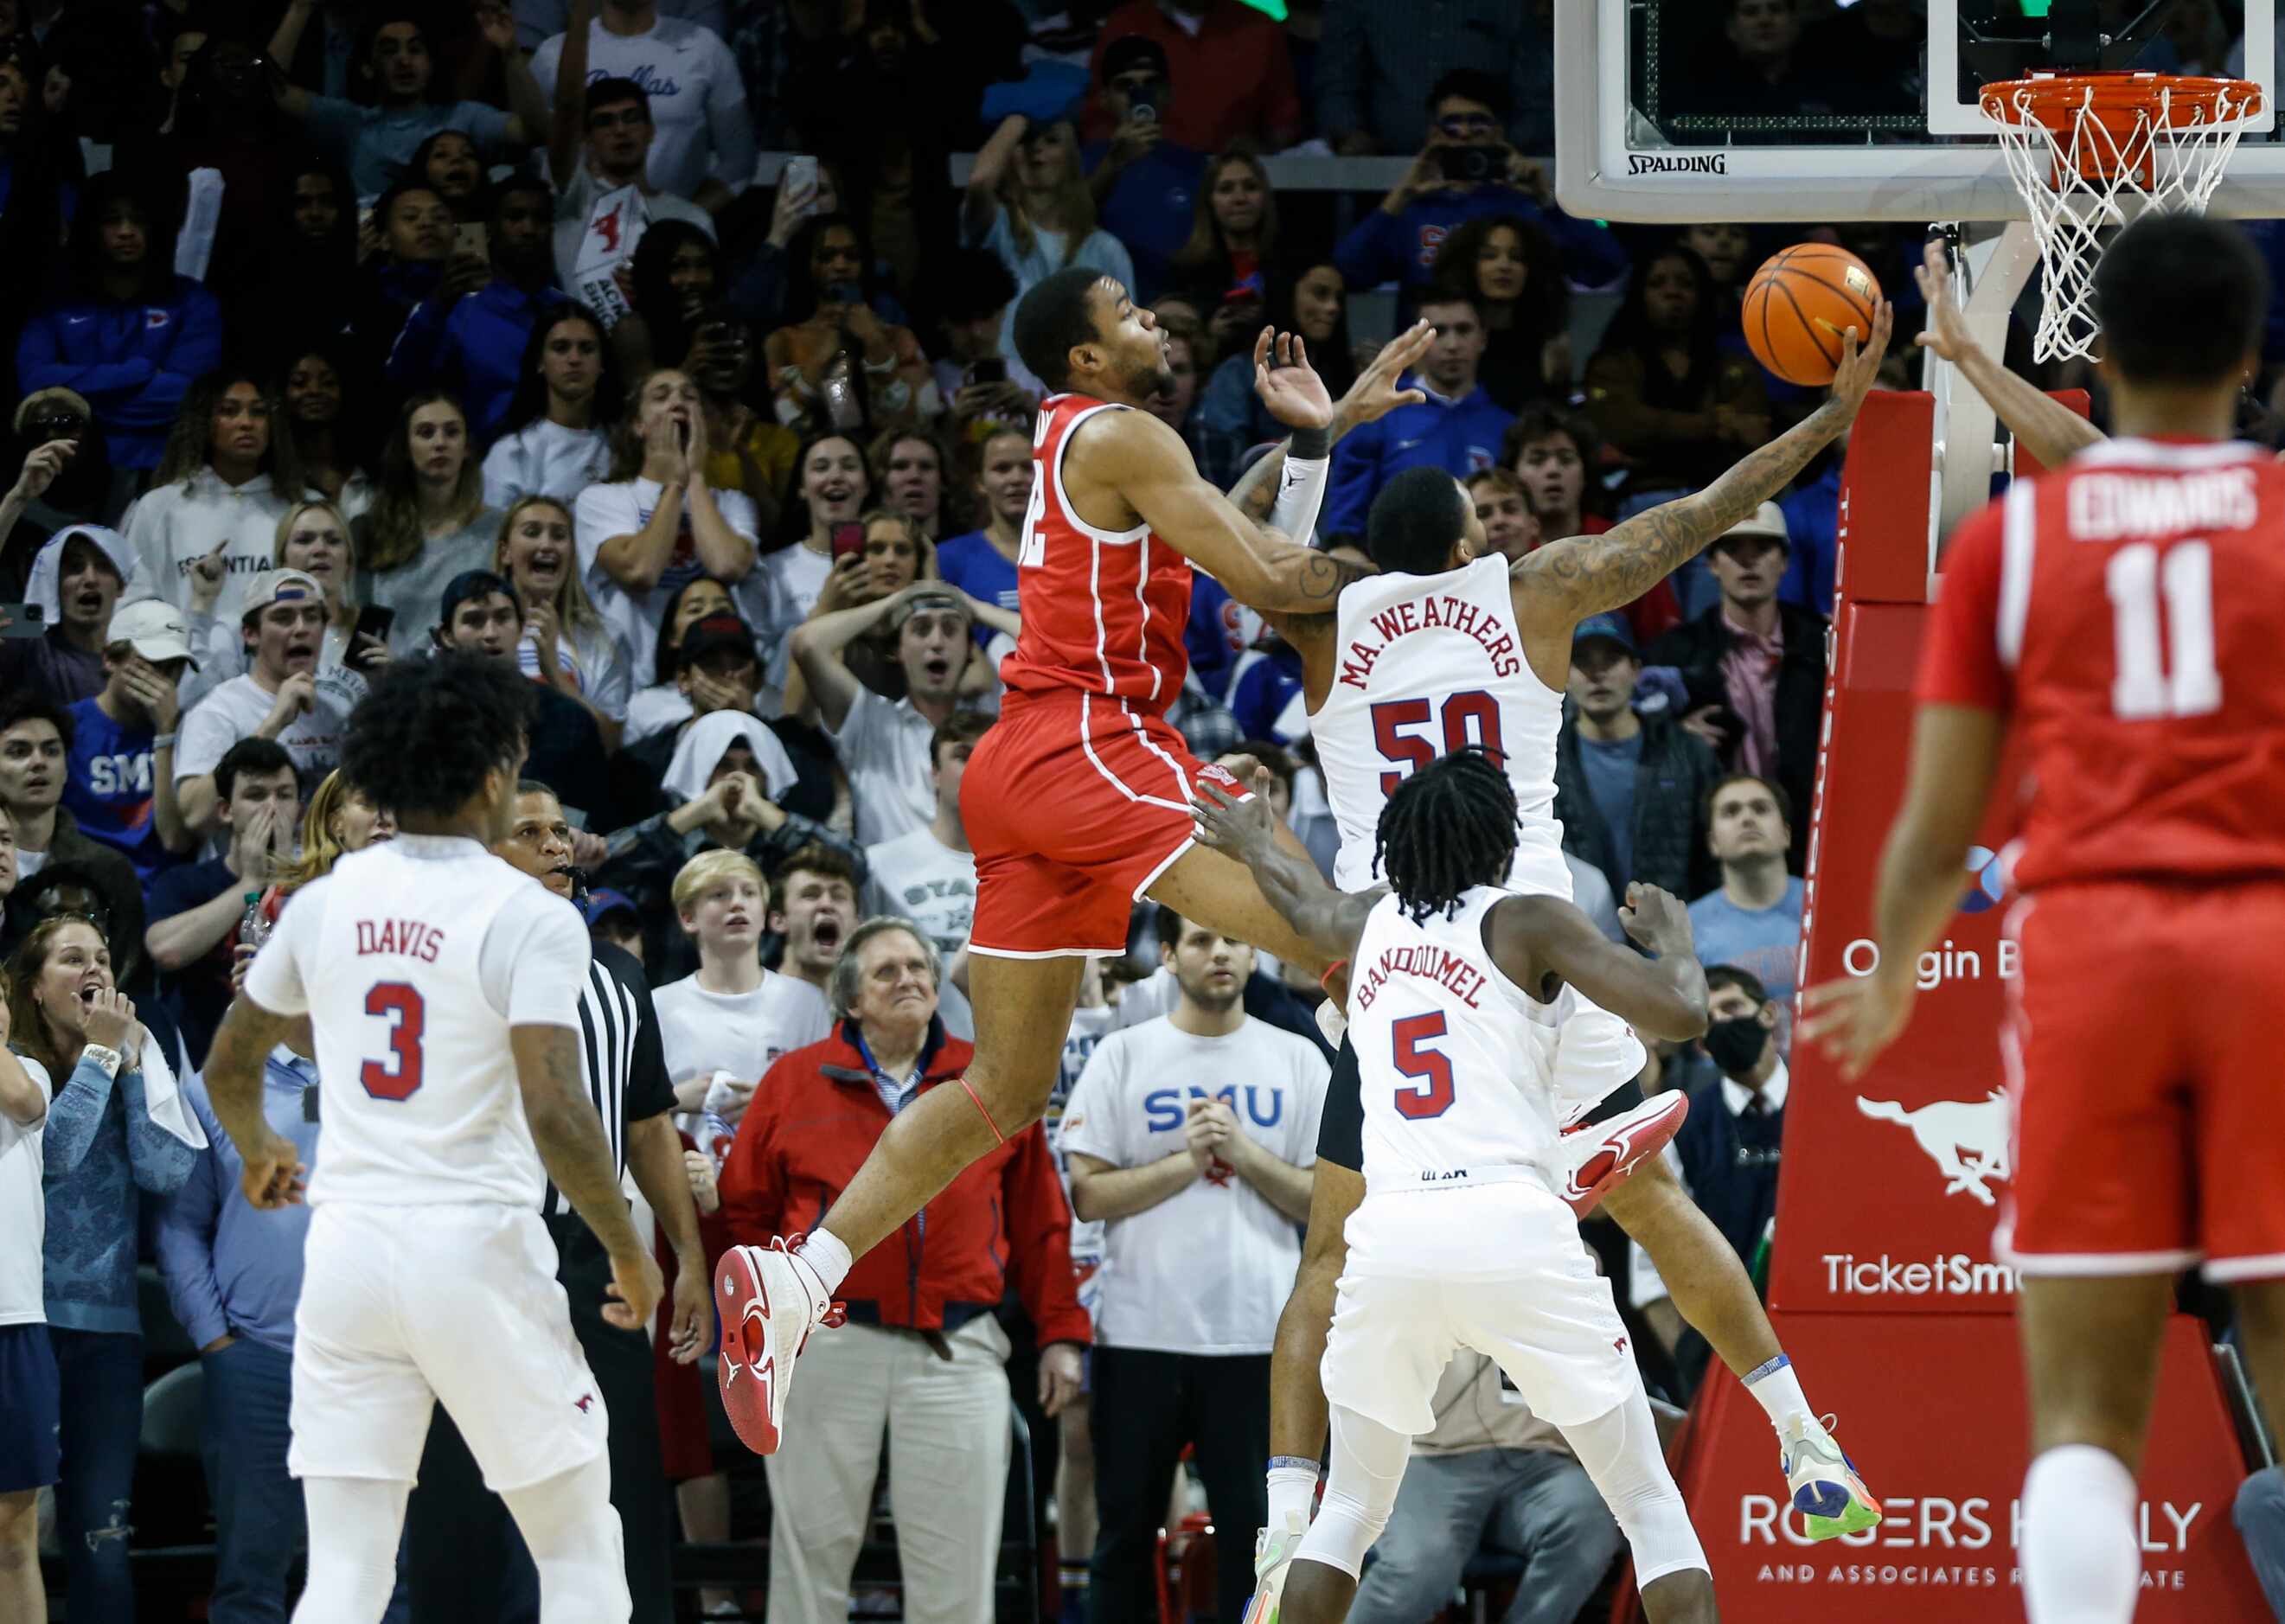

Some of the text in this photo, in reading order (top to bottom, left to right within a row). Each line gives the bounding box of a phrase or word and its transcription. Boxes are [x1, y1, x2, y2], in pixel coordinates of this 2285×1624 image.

[1629, 154, 1725, 175] SPALDING
[2107, 538, 2223, 719] 11
[90, 753, 156, 794] SM
[1370, 689, 1507, 802] 50
[356, 918, 445, 962] DAVIS
[1843, 939, 1981, 990] Ogin
[1357, 945, 1487, 1012] BANDOUMEL
[360, 981, 426, 1102] 3
[1392, 1009, 1456, 1121] 5
[1758, 1564, 1815, 1583] AND
[1828, 1566, 1997, 1587] ASSOCIATES
